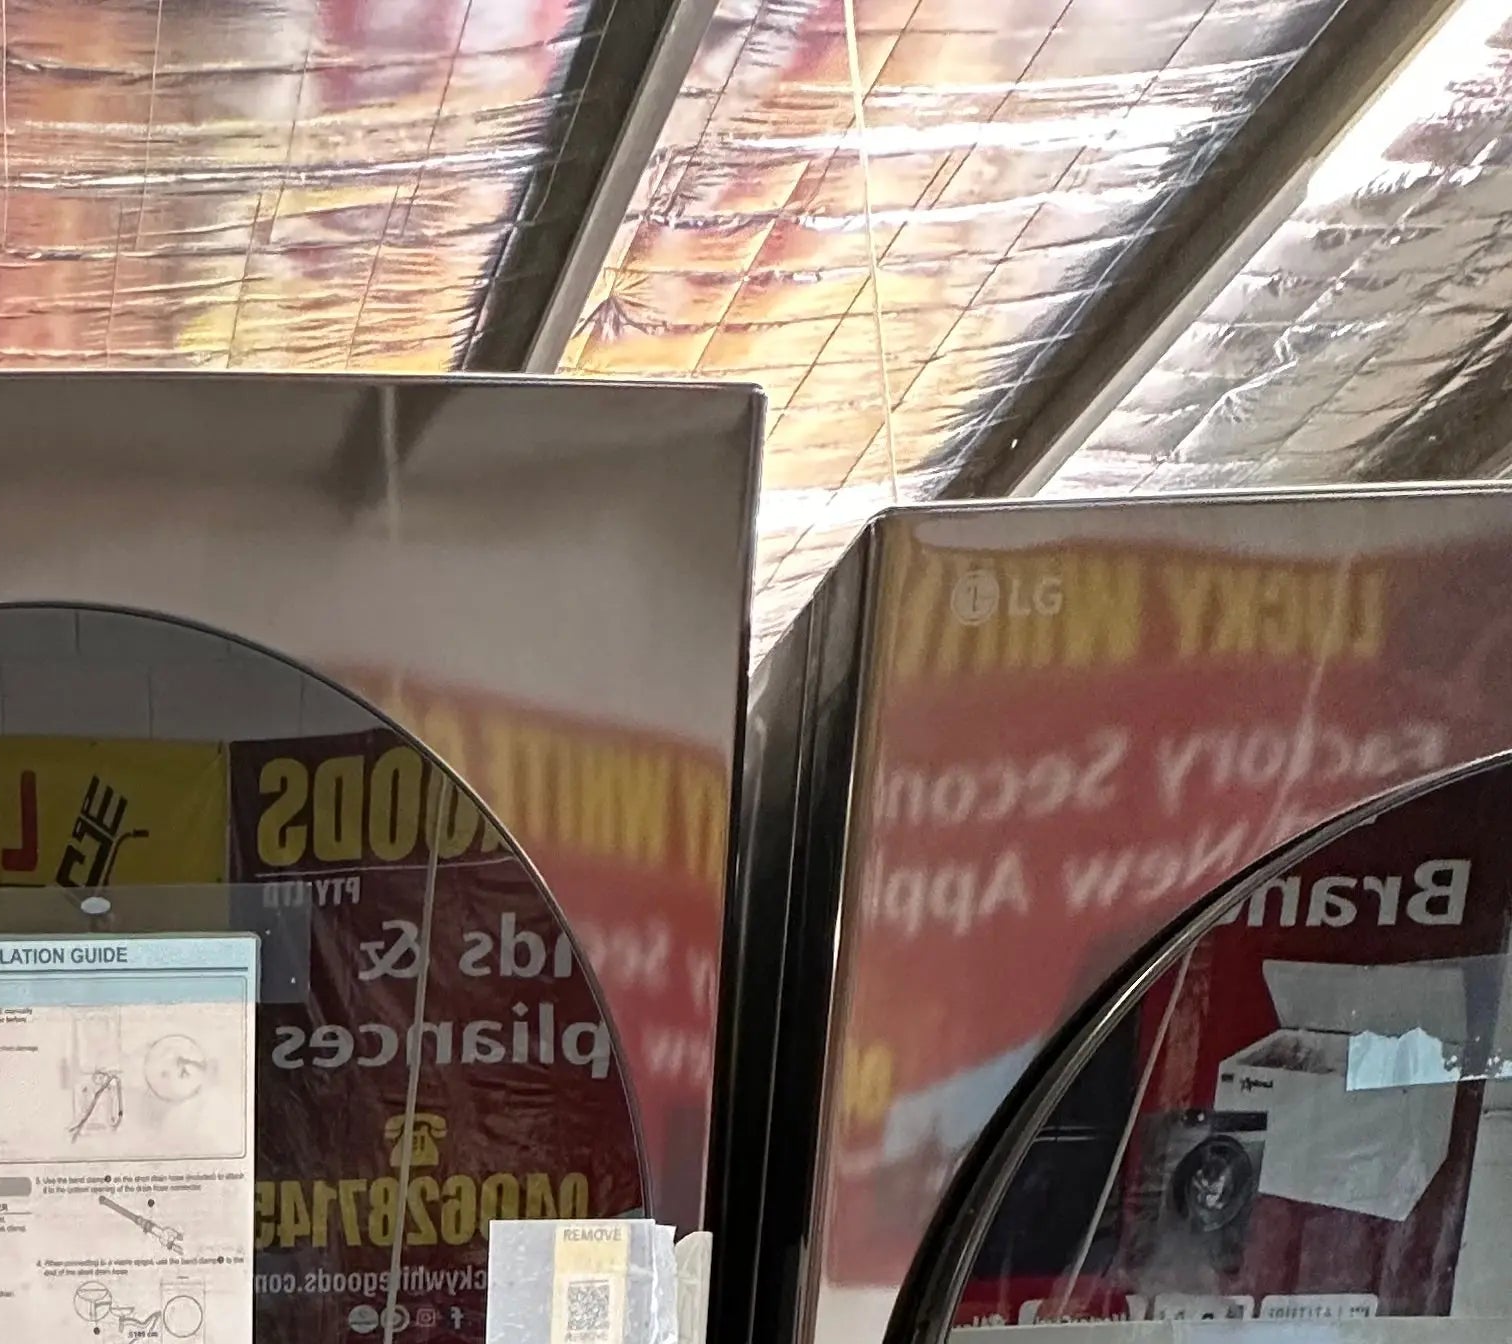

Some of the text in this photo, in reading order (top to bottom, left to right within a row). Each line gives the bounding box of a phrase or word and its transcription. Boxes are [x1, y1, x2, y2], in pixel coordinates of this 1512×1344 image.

[1006, 576, 1065, 619] LG
[70, 946, 128, 964] GUIDE
[563, 1227, 623, 1242] REMOVE
